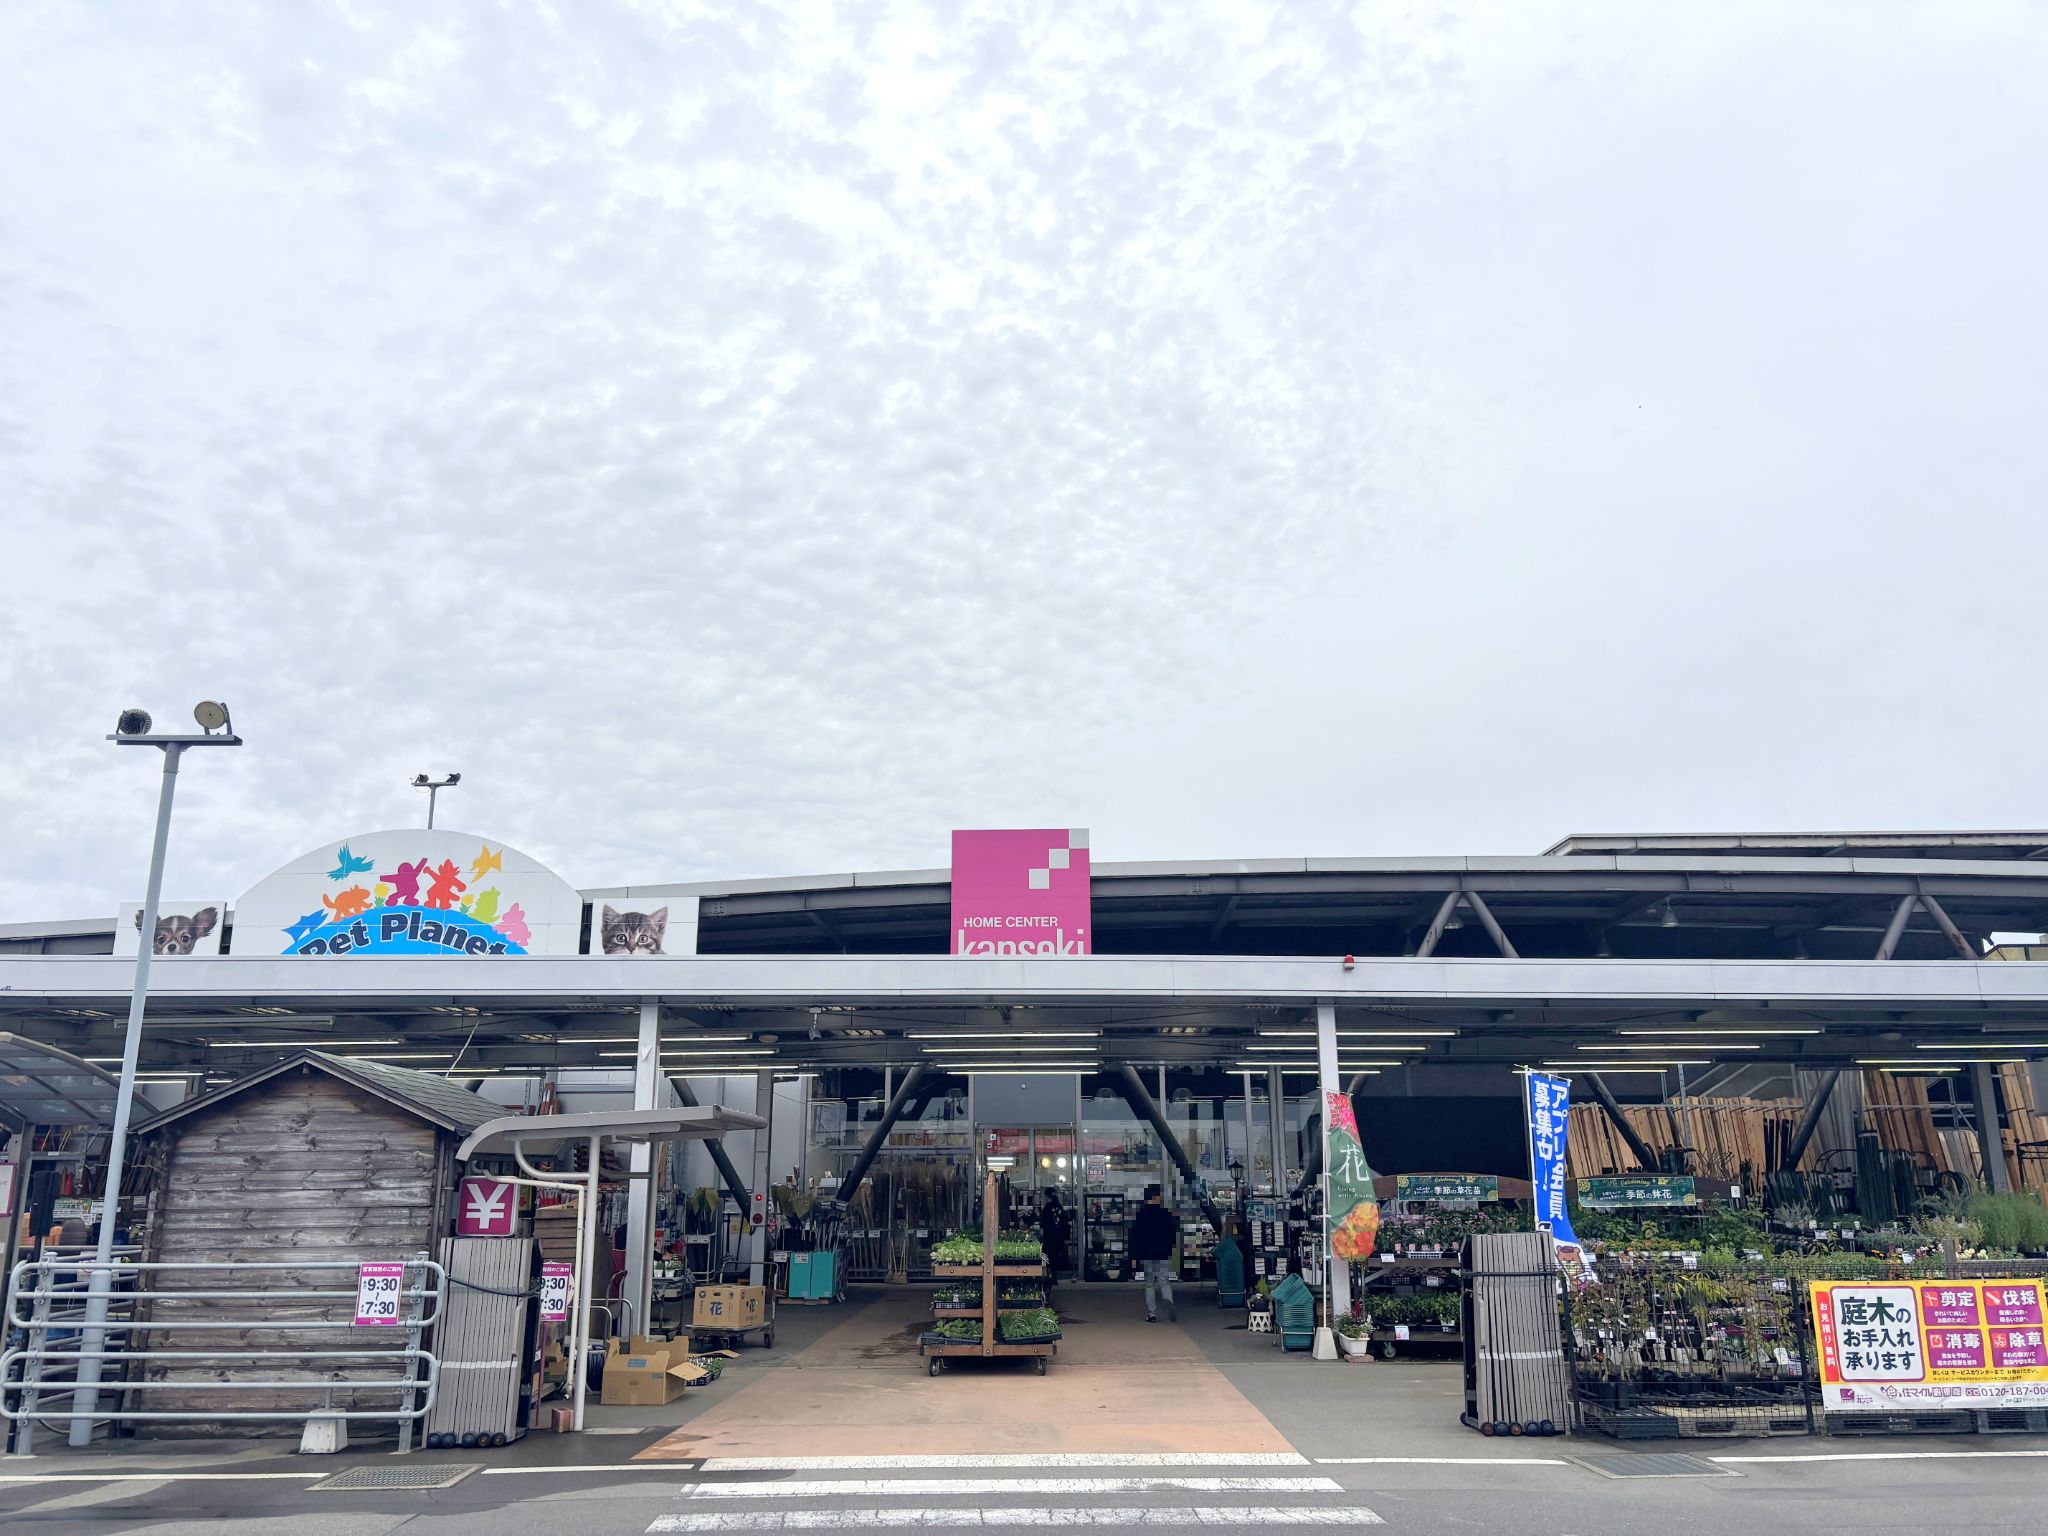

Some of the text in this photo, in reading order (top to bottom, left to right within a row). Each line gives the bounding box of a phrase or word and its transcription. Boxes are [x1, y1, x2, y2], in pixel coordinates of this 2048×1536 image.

[963, 916, 1059, 928] HOME CENTER
[298, 919, 372, 955] Pet
[1335, 1144, 1370, 1184] 花
[1625, 1188, 1673, 1200] 季節の鉢花
[465, 1183, 510, 1230] ¥
[367, 1277, 398, 1292] 9:30
[1940, 1291, 1975, 1308] 剪定
[2002, 1289, 2037, 1307] 伐採
[365, 1301, 396, 1315] 7:30
[710, 1300, 723, 1316] 花
[1839, 1296, 1912, 1326] 庭木の
[1819, 1301, 1837, 1368] お見積り無料
[1843, 1328, 1915, 1348] お手入れ
[1945, 1333, 1981, 1350] 消毒
[2008, 1331, 2043, 1349] 除草
[1845, 1351, 1916, 1371] 承ります
[1980, 1385, 2048, 1397] 0120-187-00
